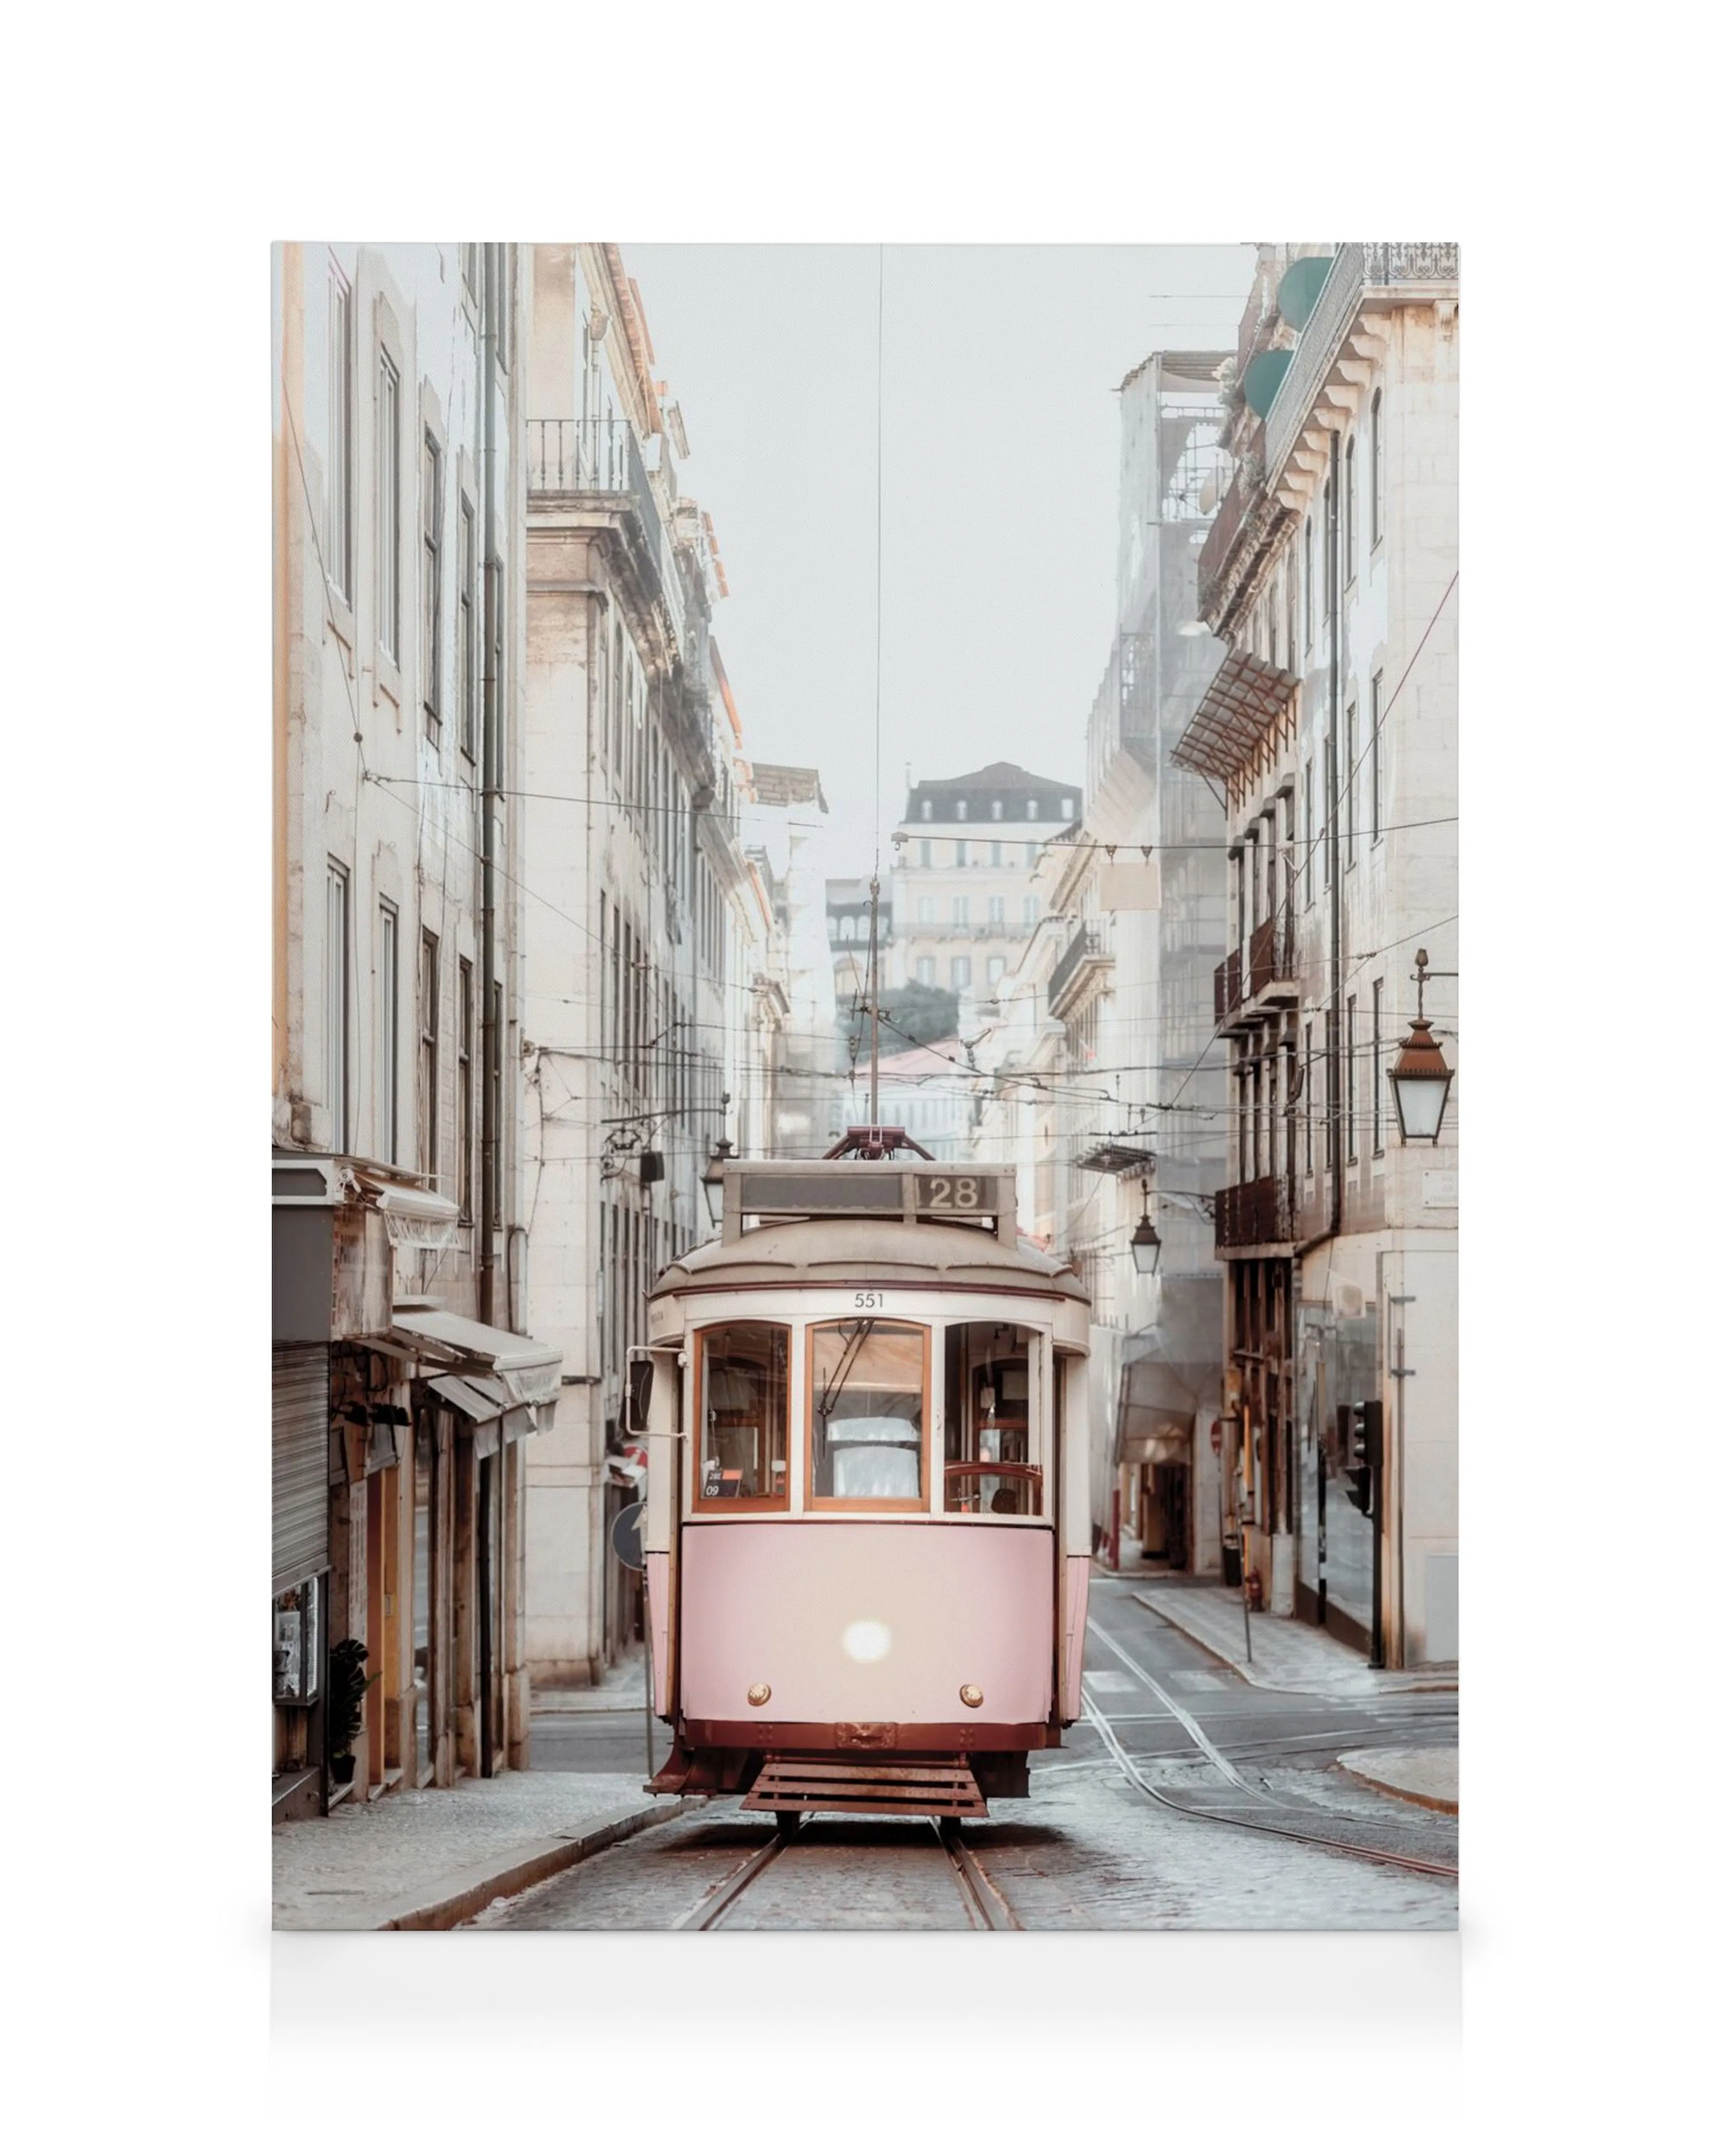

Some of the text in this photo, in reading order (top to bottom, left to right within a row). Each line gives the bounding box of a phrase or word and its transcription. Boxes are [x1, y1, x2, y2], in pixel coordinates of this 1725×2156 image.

[929, 1177, 978, 1208] 28
[854, 1293, 883, 1308] 551
[706, 1485, 719, 1496] 09
